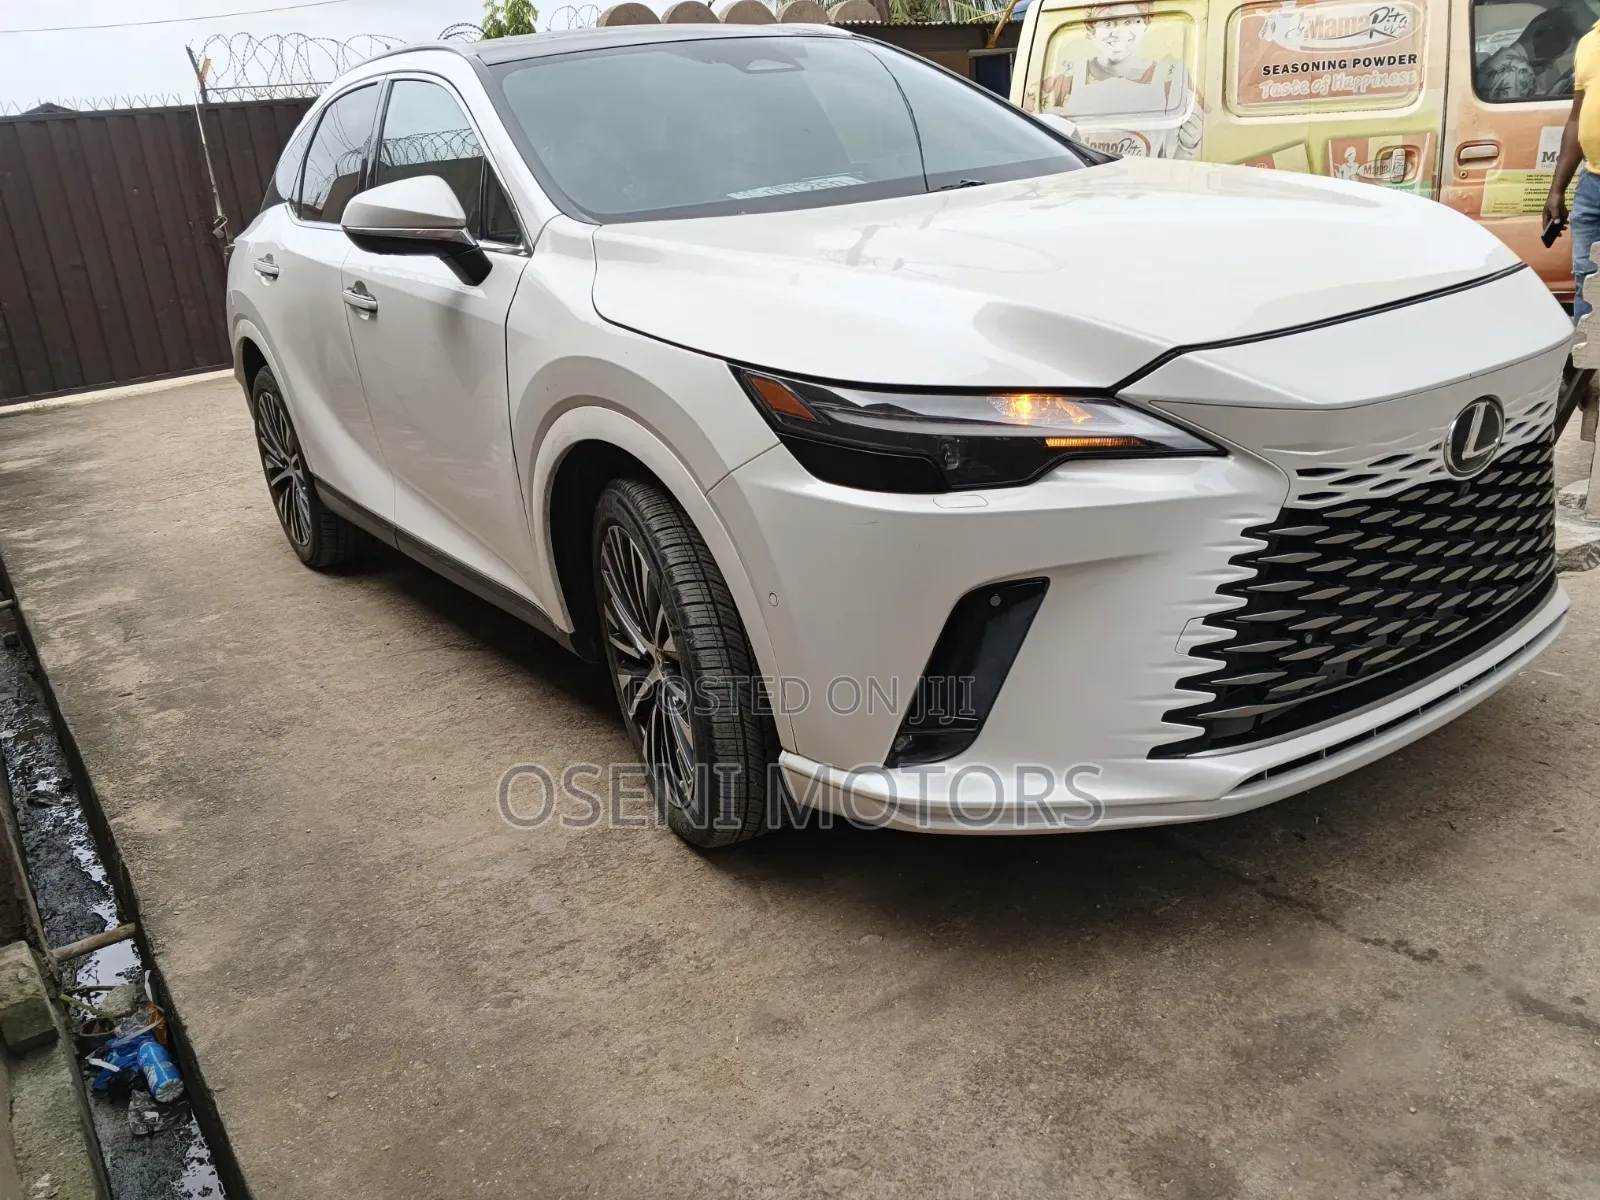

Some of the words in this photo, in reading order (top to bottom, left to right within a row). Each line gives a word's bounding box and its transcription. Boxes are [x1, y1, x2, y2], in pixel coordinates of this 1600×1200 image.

[1262, 60, 1347, 76] SEASONING
[1352, 54, 1418, 69] POWDER
[1259, 79, 1309, 99] Taste
[1310, 74, 1331, 95] of
[1332, 70, 1418, 93] Happiness
